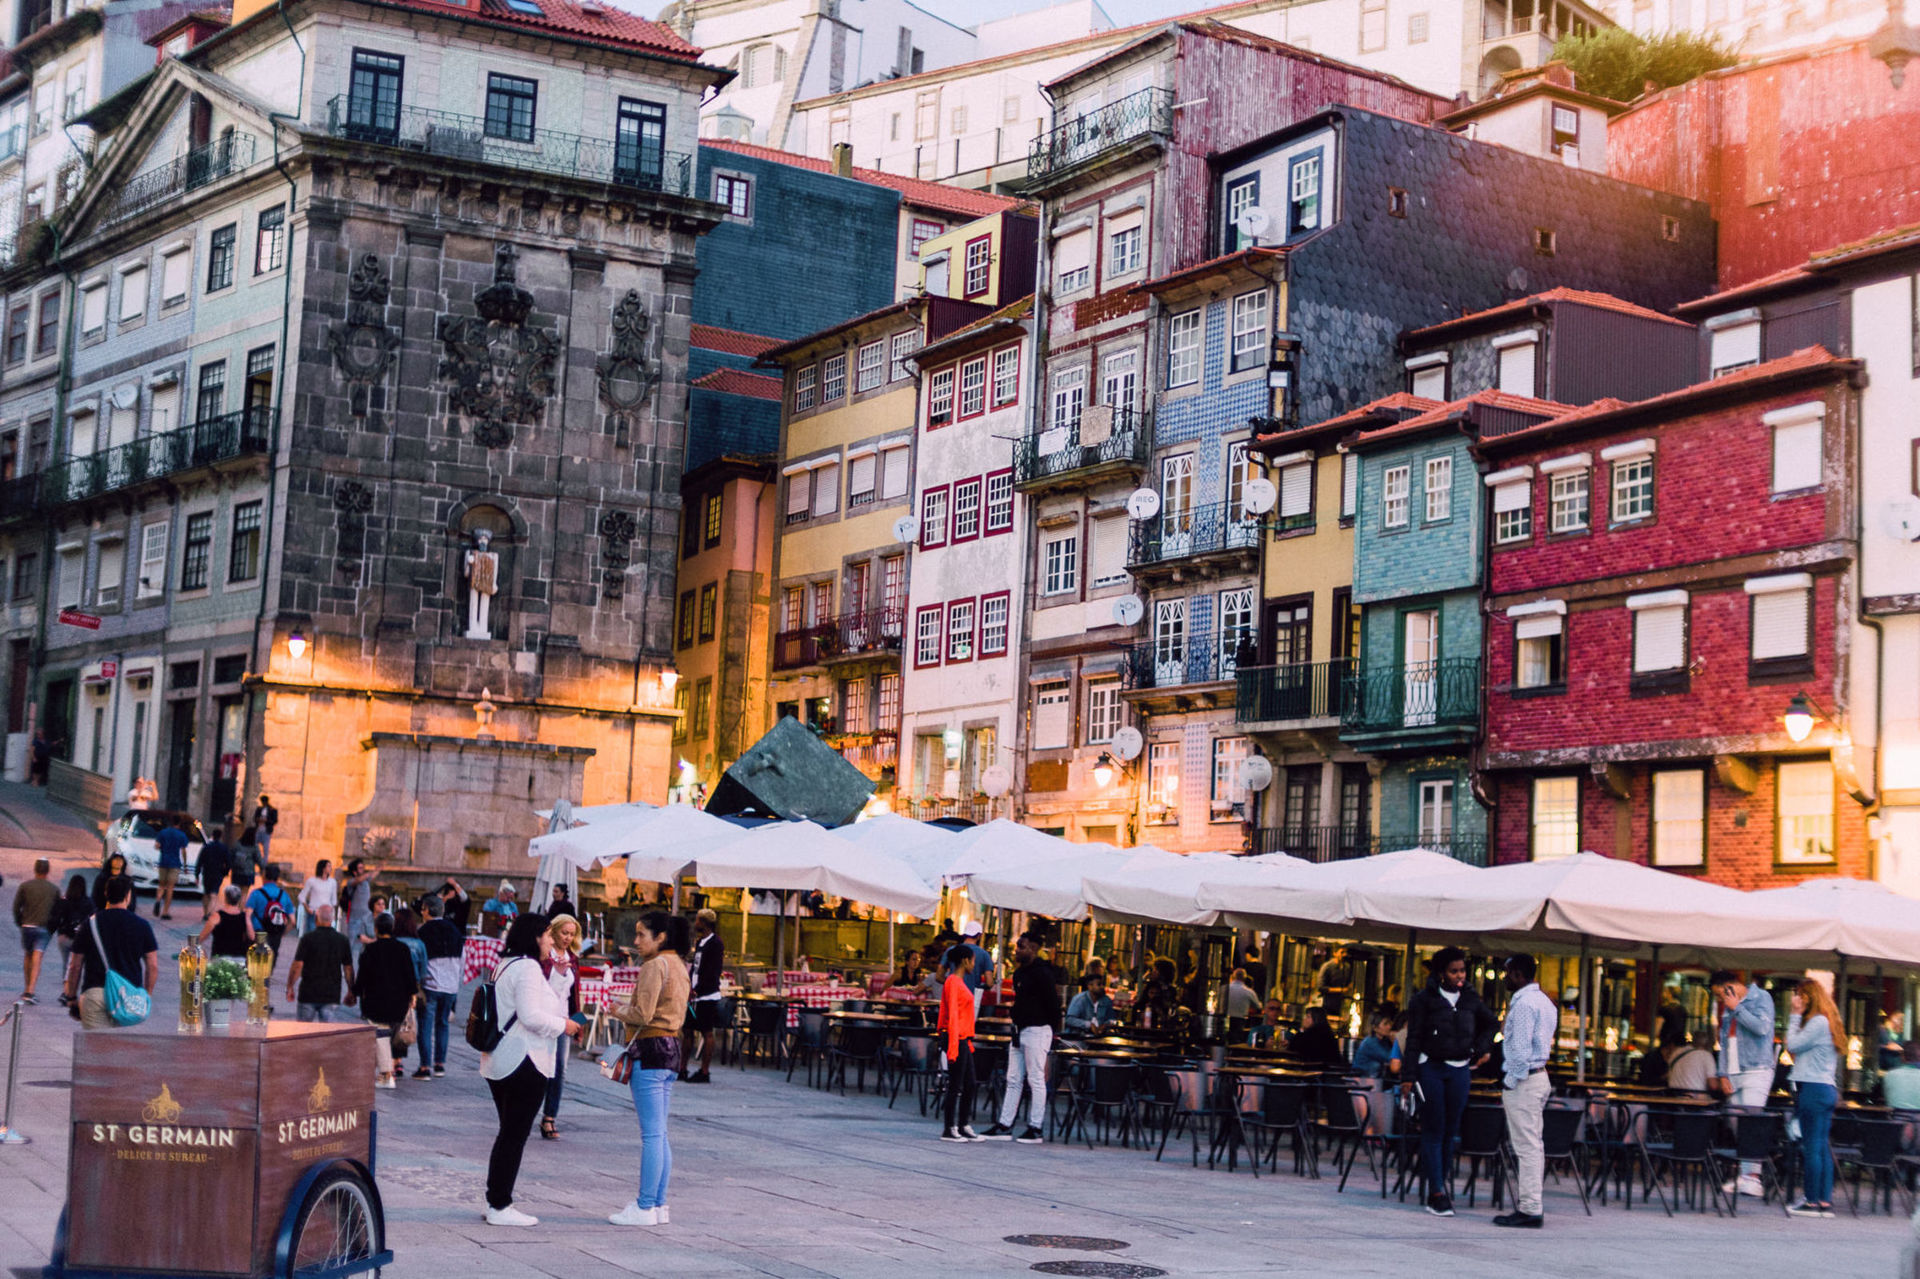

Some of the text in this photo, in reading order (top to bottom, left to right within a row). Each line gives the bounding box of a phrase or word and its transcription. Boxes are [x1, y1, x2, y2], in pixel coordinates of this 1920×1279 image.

[93, 1124, 234, 1147] ST GERMAIN
[279, 1110, 357, 1144] ST GERMAIN
[169, 1152, 207, 1163] SUREAU
